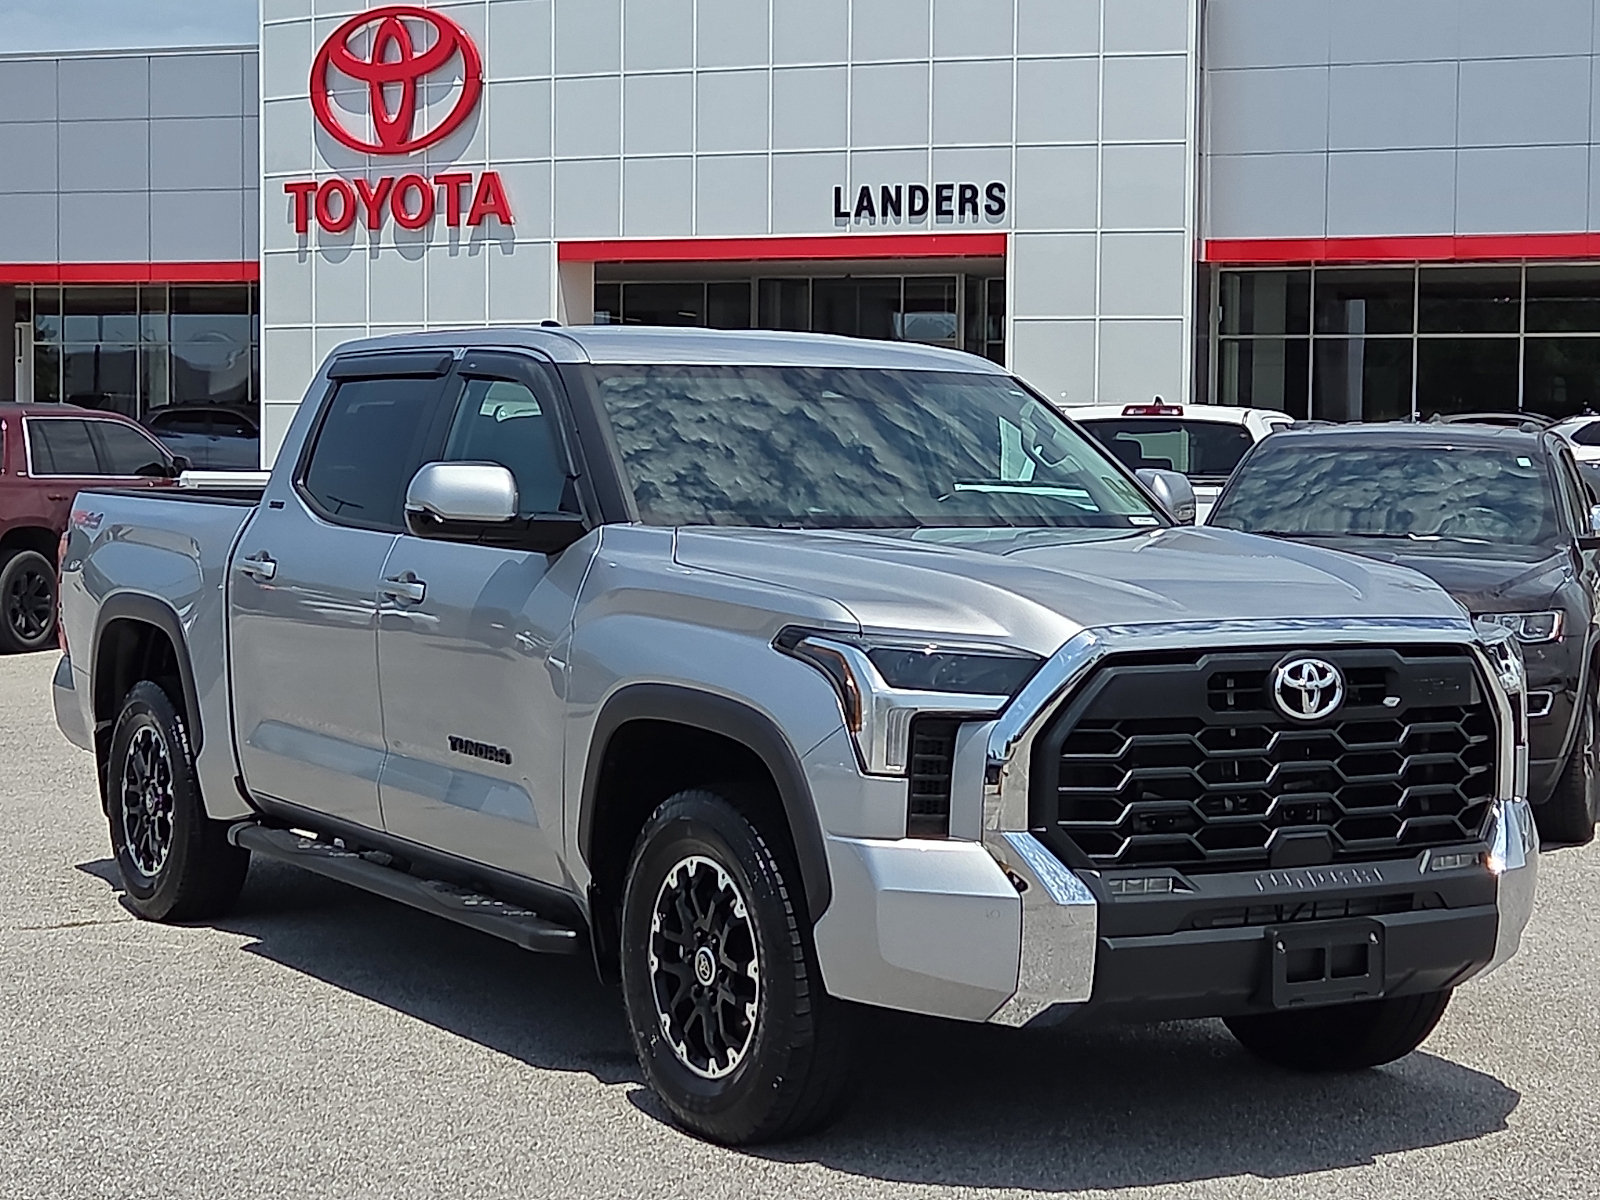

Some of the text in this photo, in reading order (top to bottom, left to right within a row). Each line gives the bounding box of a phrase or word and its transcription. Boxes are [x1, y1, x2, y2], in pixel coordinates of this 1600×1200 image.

[285, 171, 514, 233] TOYOTA
[834, 182, 1006, 218] LANDERS
[448, 735, 512, 765] TUNDRA
